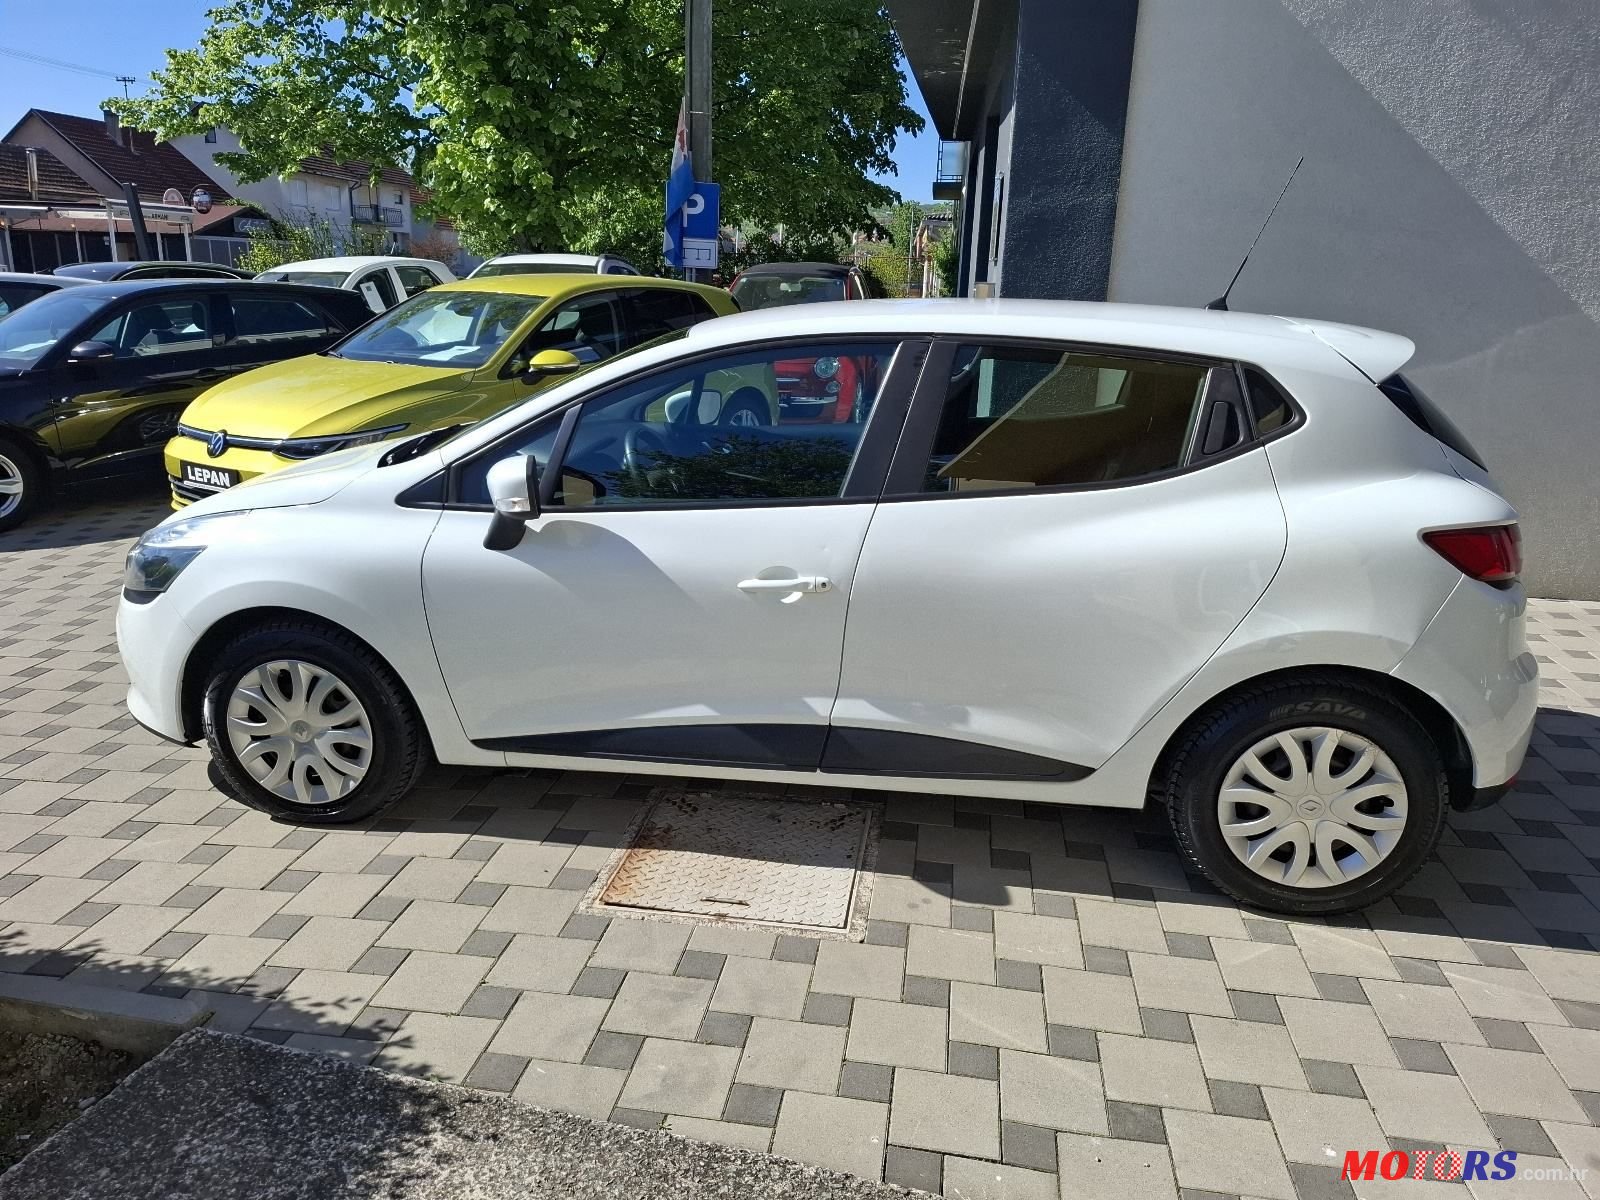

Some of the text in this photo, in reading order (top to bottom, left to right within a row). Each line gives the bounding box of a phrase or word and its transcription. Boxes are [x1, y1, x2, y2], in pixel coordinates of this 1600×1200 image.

[683, 194, 704, 227] P
[187, 465, 230, 487] LEPAN
[1296, 701, 1366, 719] SAVA
